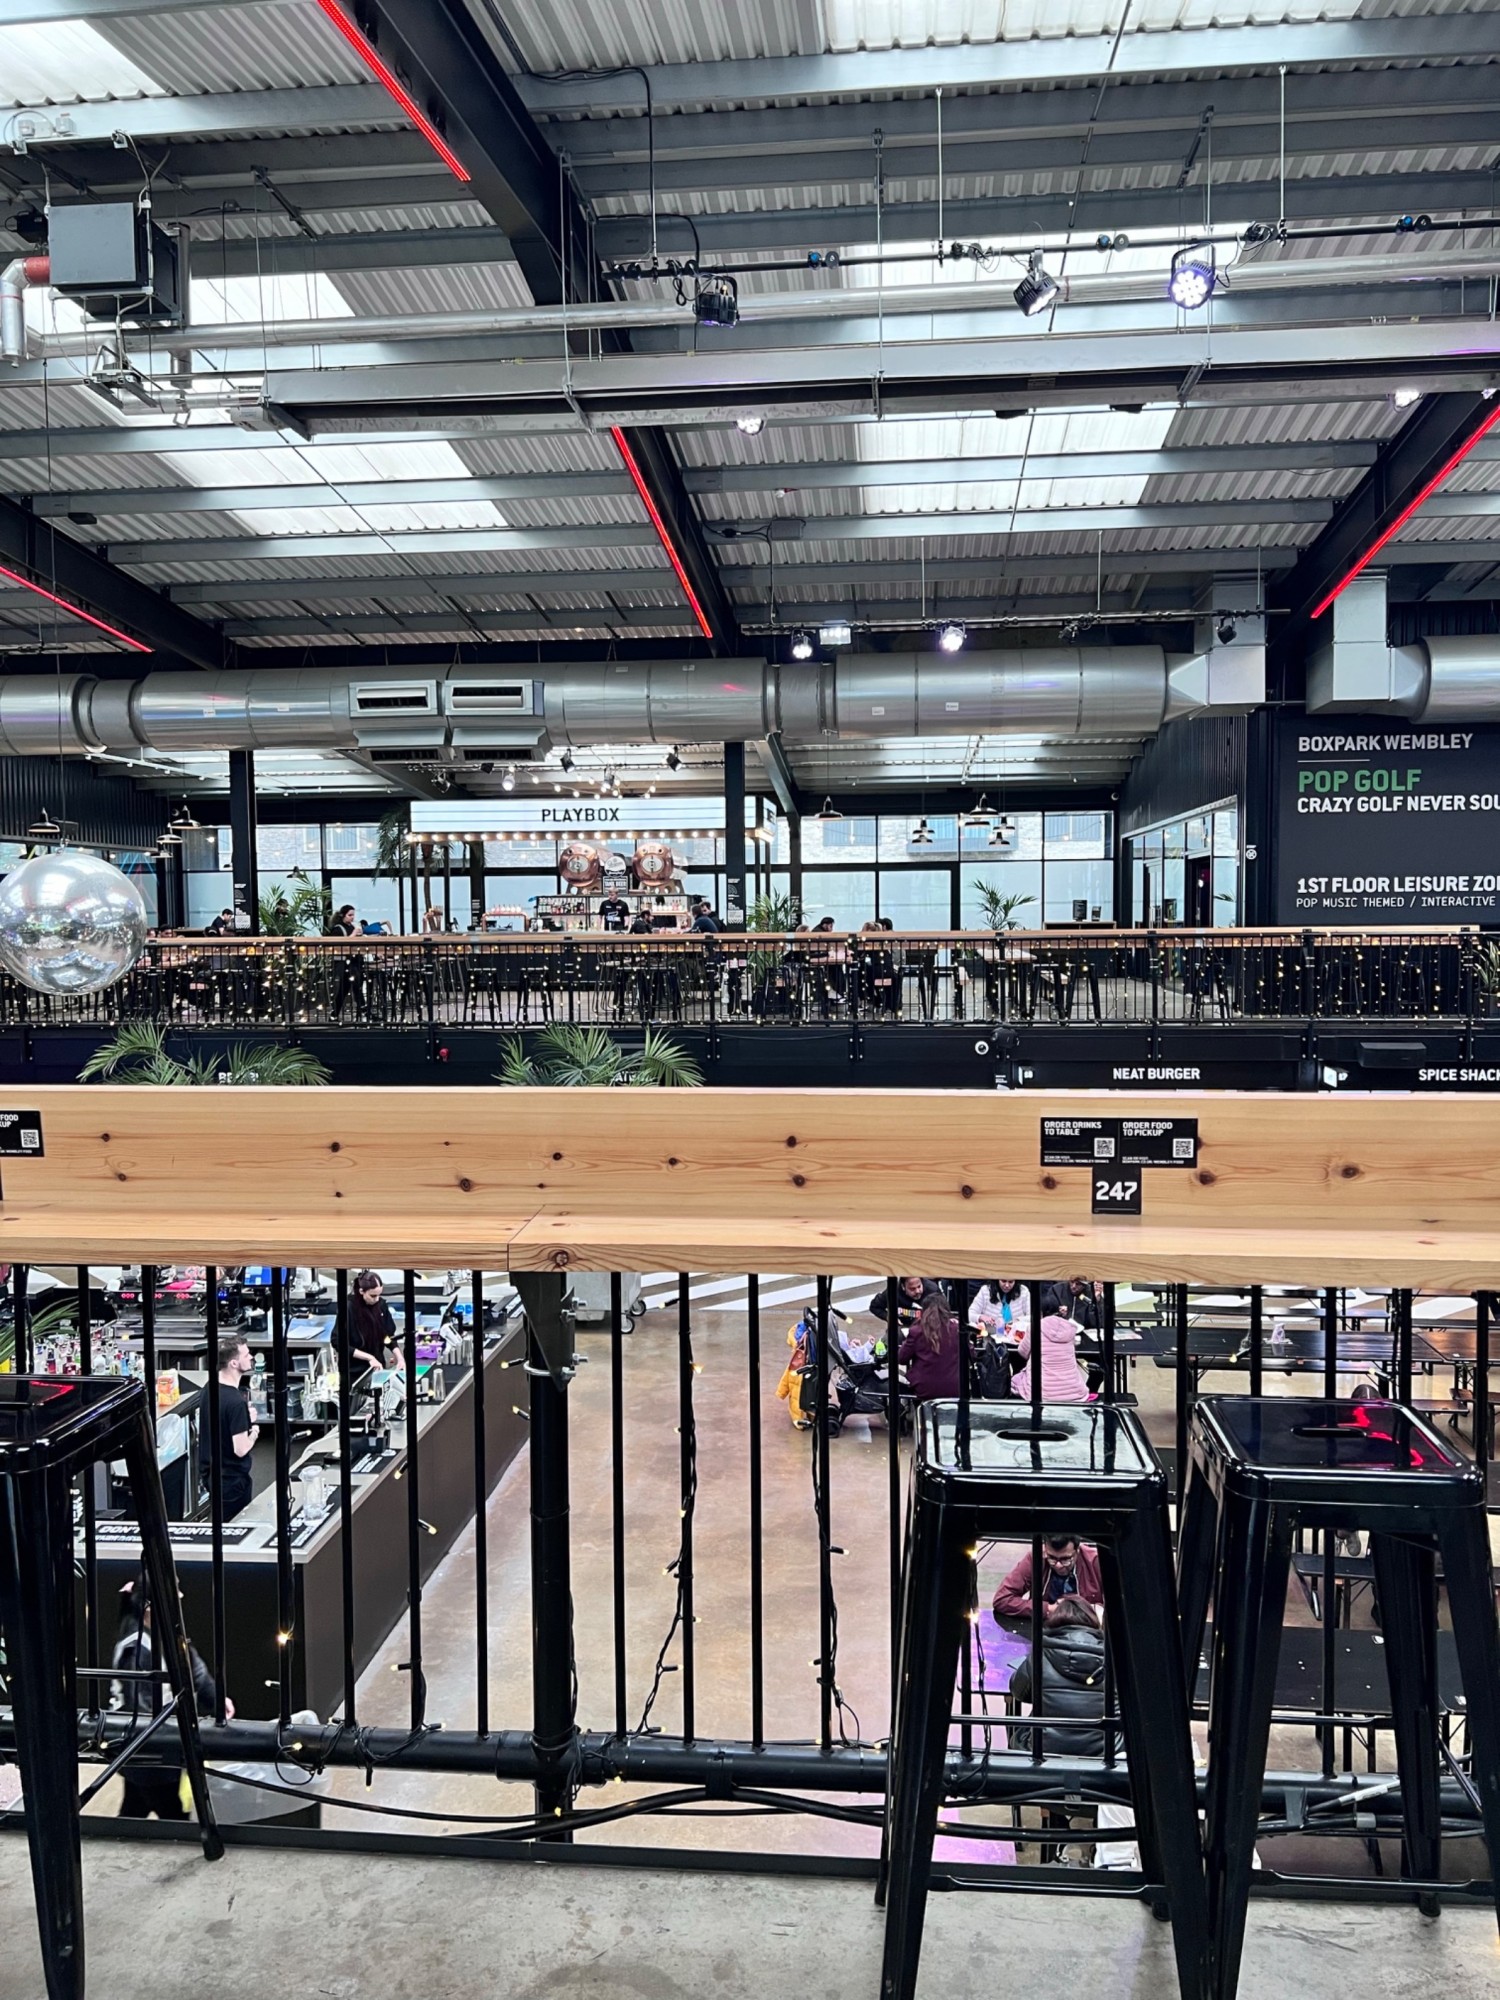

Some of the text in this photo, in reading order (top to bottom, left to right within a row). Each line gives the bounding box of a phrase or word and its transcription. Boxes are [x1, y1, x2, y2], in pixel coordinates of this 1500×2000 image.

[1298, 733, 1473, 752] BOXPARK WEMBLEY
[1298, 769, 1422, 793] POP GOLF
[1297, 797, 1354, 813] CRAZY
[1357, 796, 1404, 812] GOLF
[1407, 795, 1466, 811] NEVER
[541, 808, 619, 823] PLAYBOX
[1297, 877, 1329, 894] 1ST
[1332, 877, 1390, 893] FLOOR
[1394, 876, 1469, 892] LEISURE
[1296, 897, 1318, 908] POP
[1323, 897, 1358, 908] MUSIC
[1363, 897, 1404, 908] THEMED
[1421, 896, 1496, 907] INTERACTIVE
[1113, 1068, 1201, 1080] NEAT BURGER
[1418, 1068, 1457, 1081] SPICE
[1044, 1121, 1102, 1129] ORDER DRINKS
[1122, 1122, 1173, 1130] ORDER FOOD
[1044, 1128, 1080, 1136] TO TABLE
[1122, 1129, 1164, 1137] TO PICKUP
[1095, 1181, 1138, 1201] 247
[167, 1527, 248, 1536] POINTLSS!
